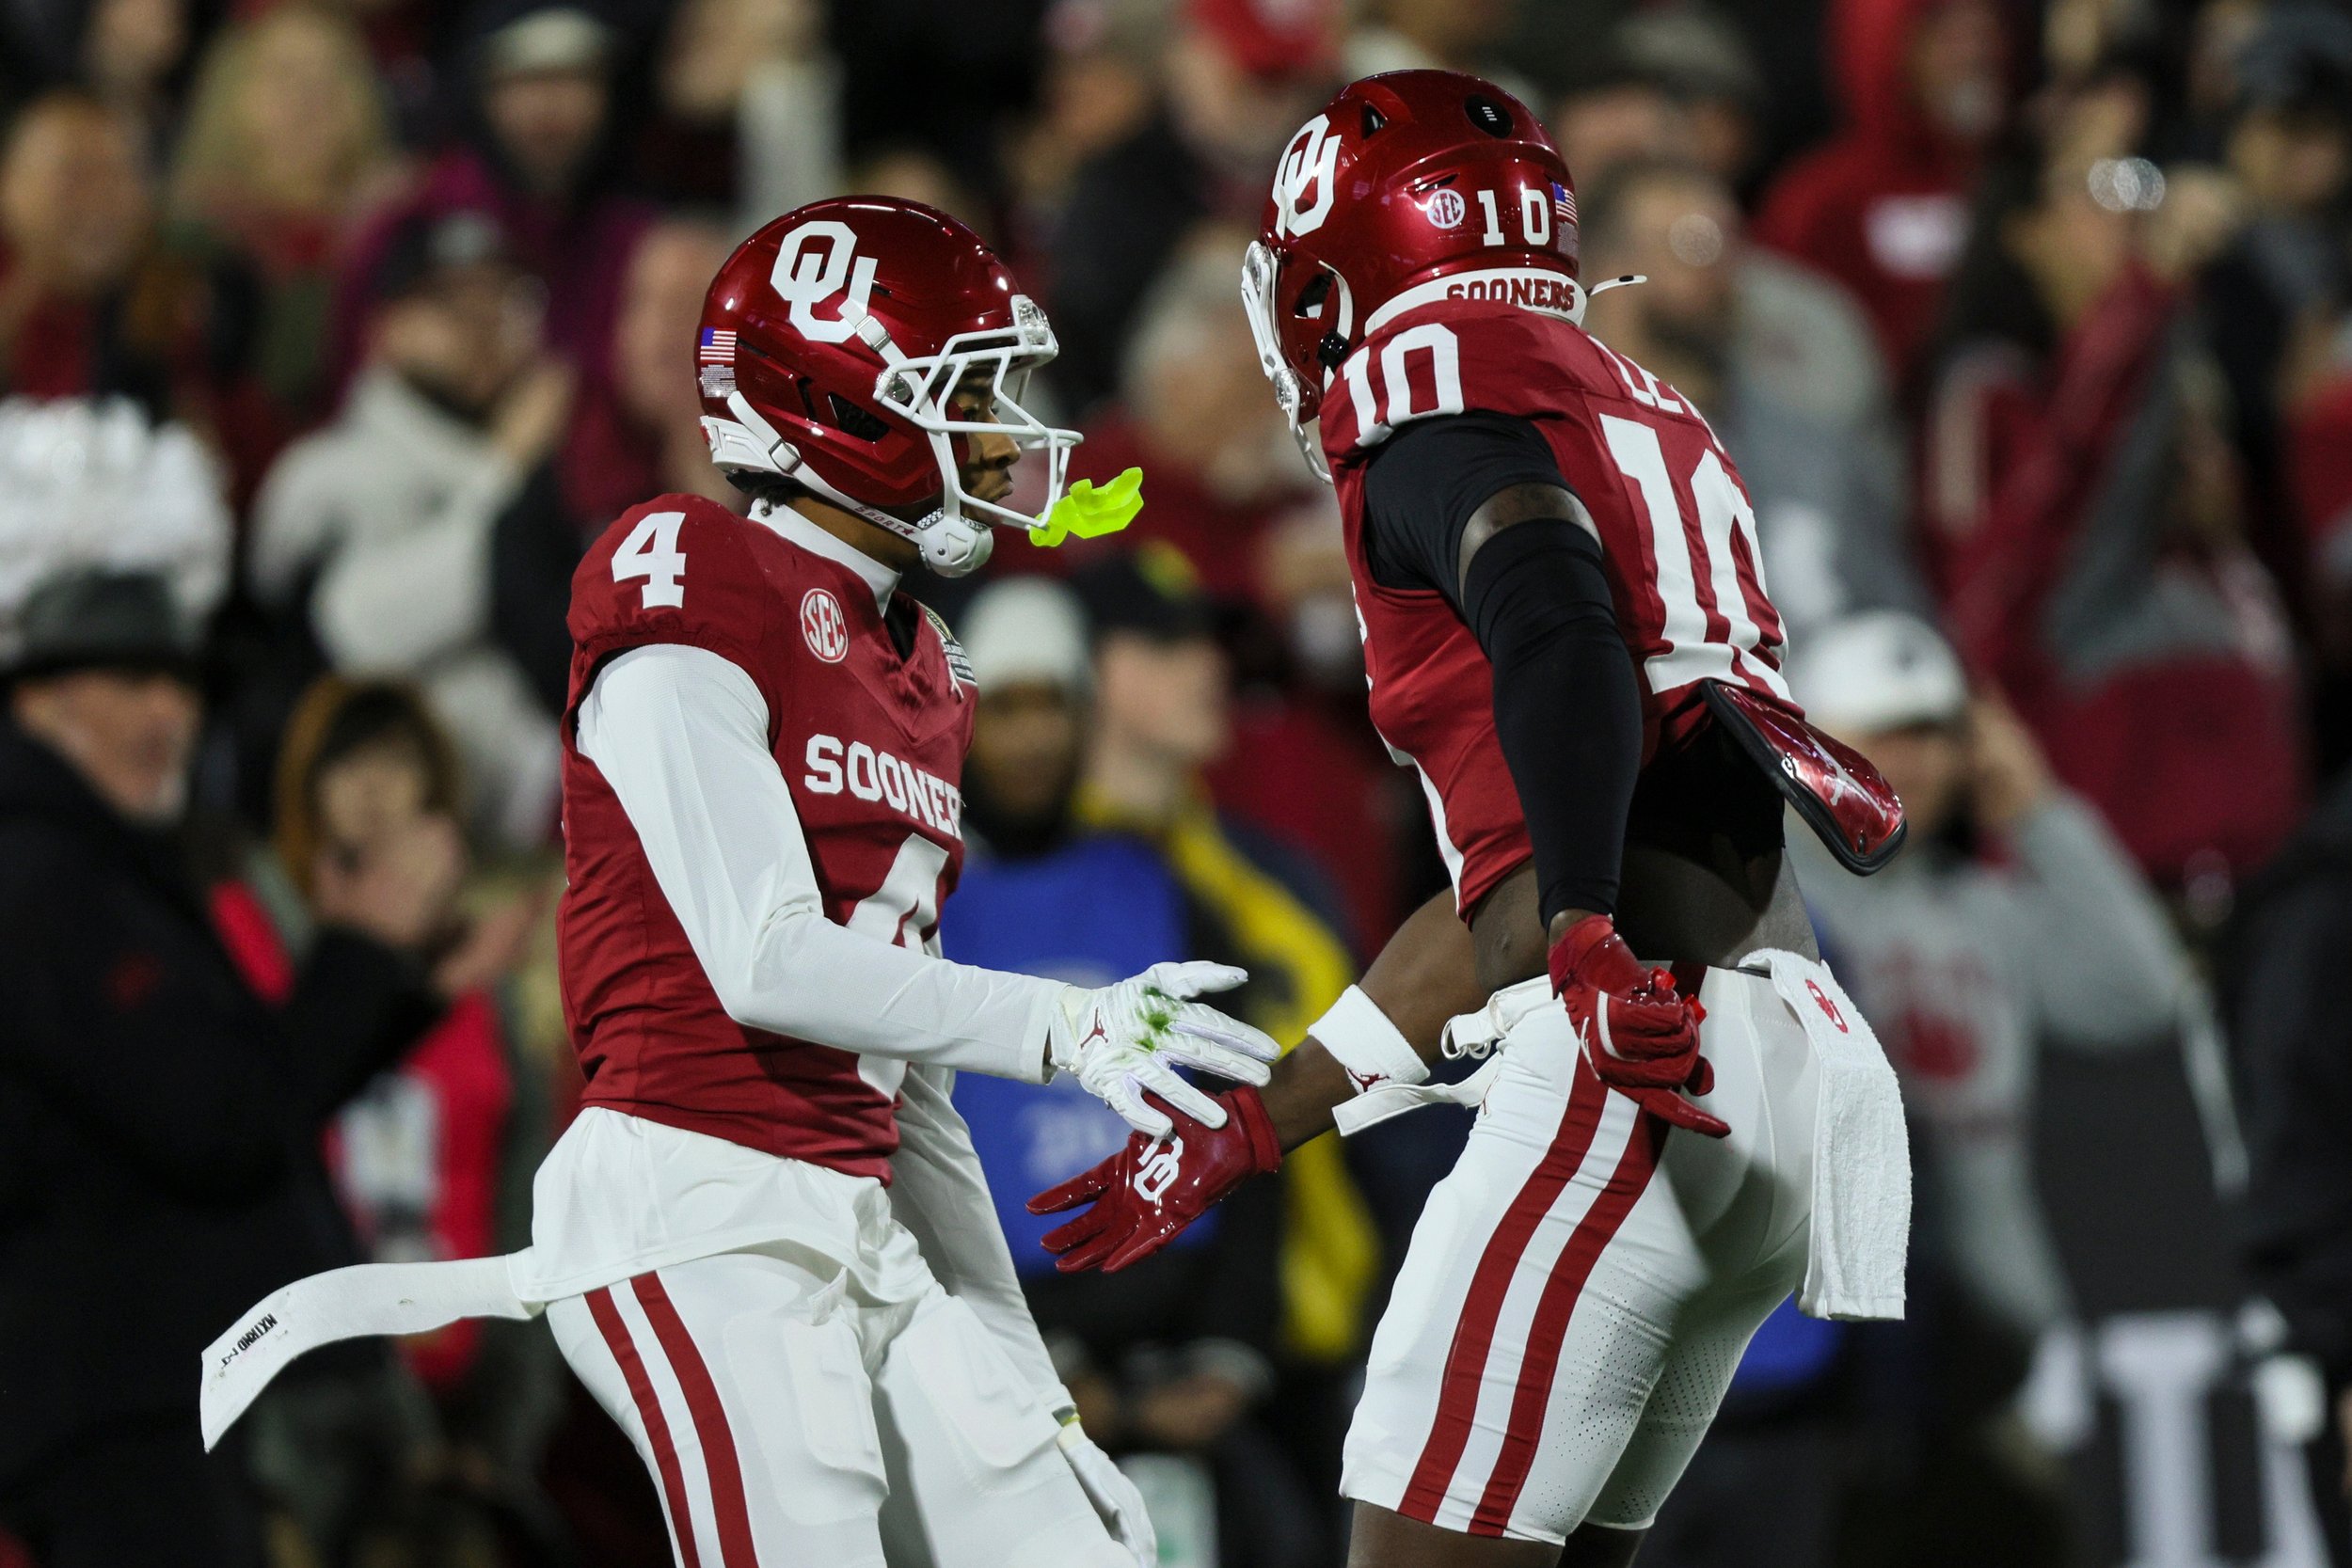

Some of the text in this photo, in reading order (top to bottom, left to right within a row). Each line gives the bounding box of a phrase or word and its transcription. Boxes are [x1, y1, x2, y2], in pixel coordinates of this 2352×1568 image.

[1432, 191, 1461, 226] SEC
[1477, 189, 1550, 246] 10
[771, 220, 879, 343] OU
[1446, 277, 1576, 312] SOONERS
[1343, 323, 1465, 447] 10
[612, 512, 687, 610] 4
[1598, 413, 1792, 708] 10
[805, 594, 846, 657] SEC
[237, 1313, 278, 1352] NXTRND
